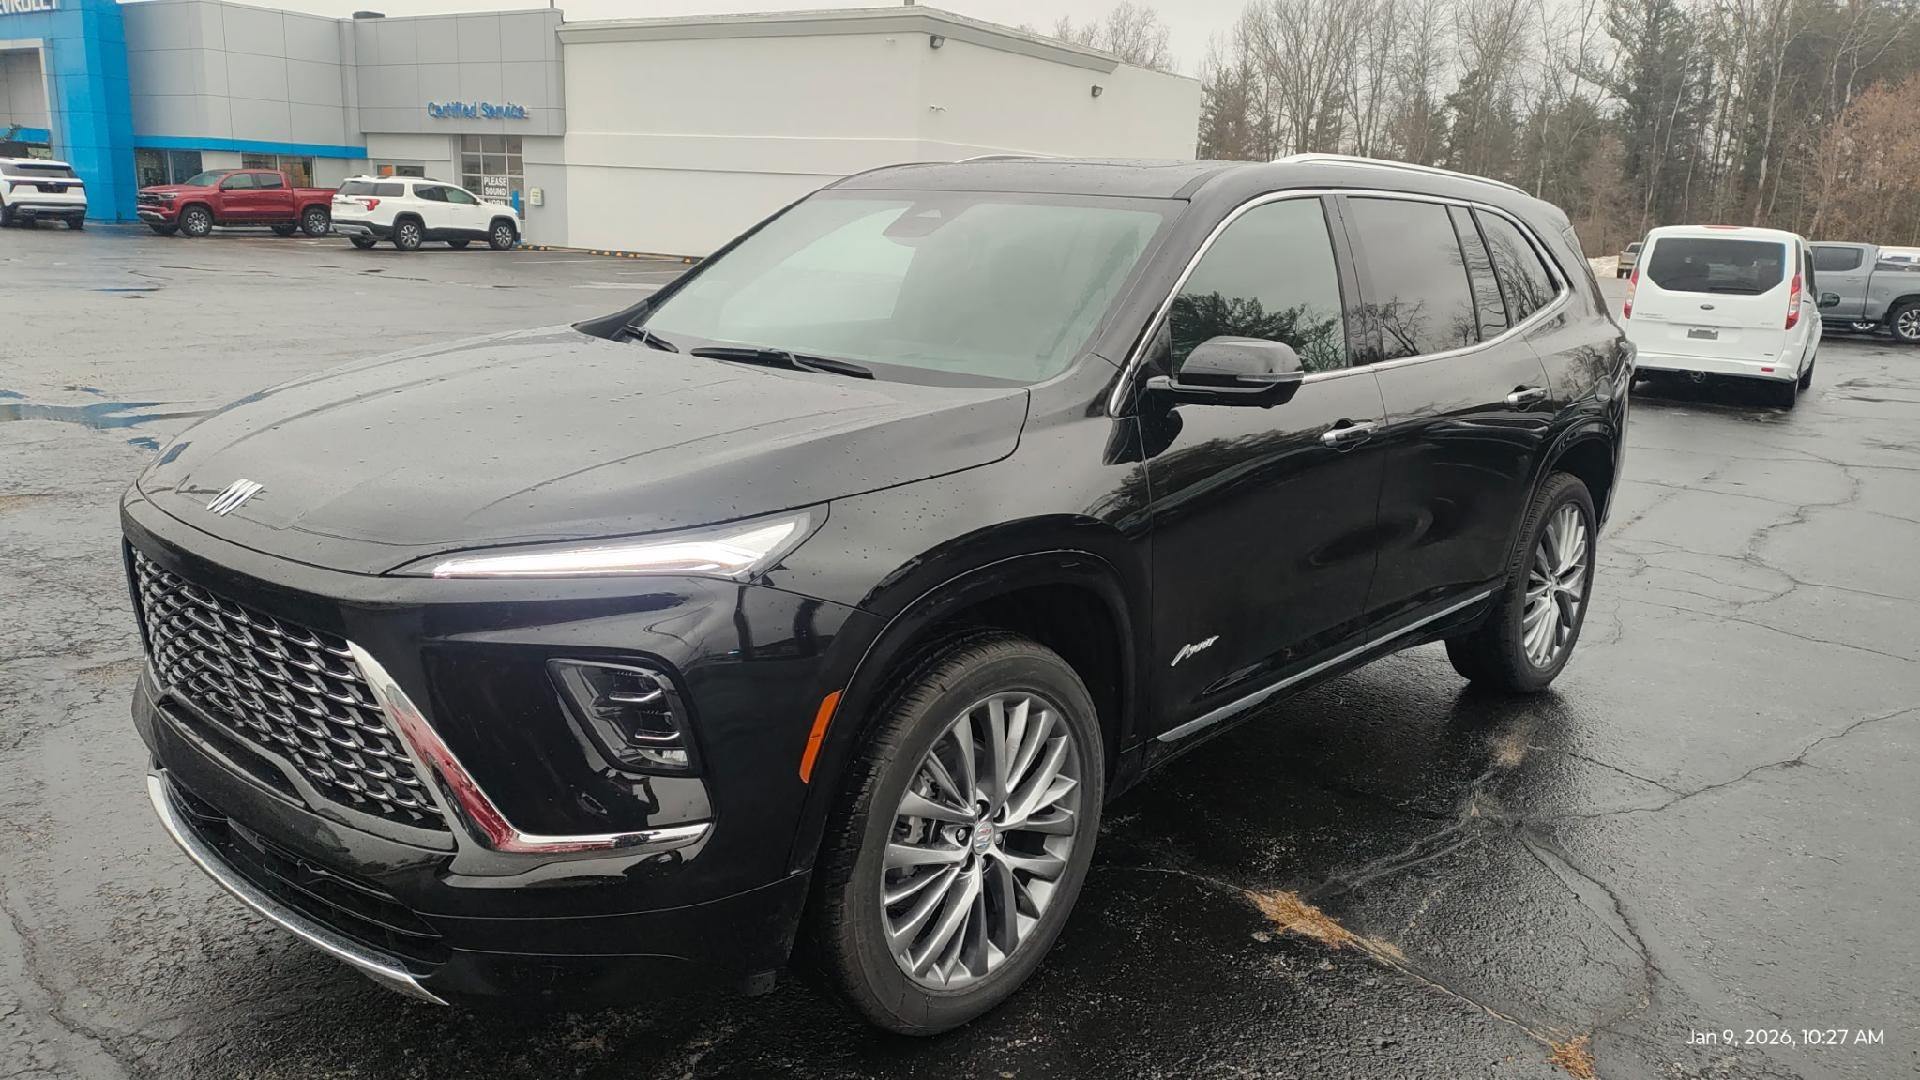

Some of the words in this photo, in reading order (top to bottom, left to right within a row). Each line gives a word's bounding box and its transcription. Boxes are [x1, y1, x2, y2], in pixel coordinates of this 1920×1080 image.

[428, 101, 478, 119] Certified
[480, 102, 529, 119] Service
[484, 176, 506, 186] PLEASE
[485, 187, 506, 196] SOUND
